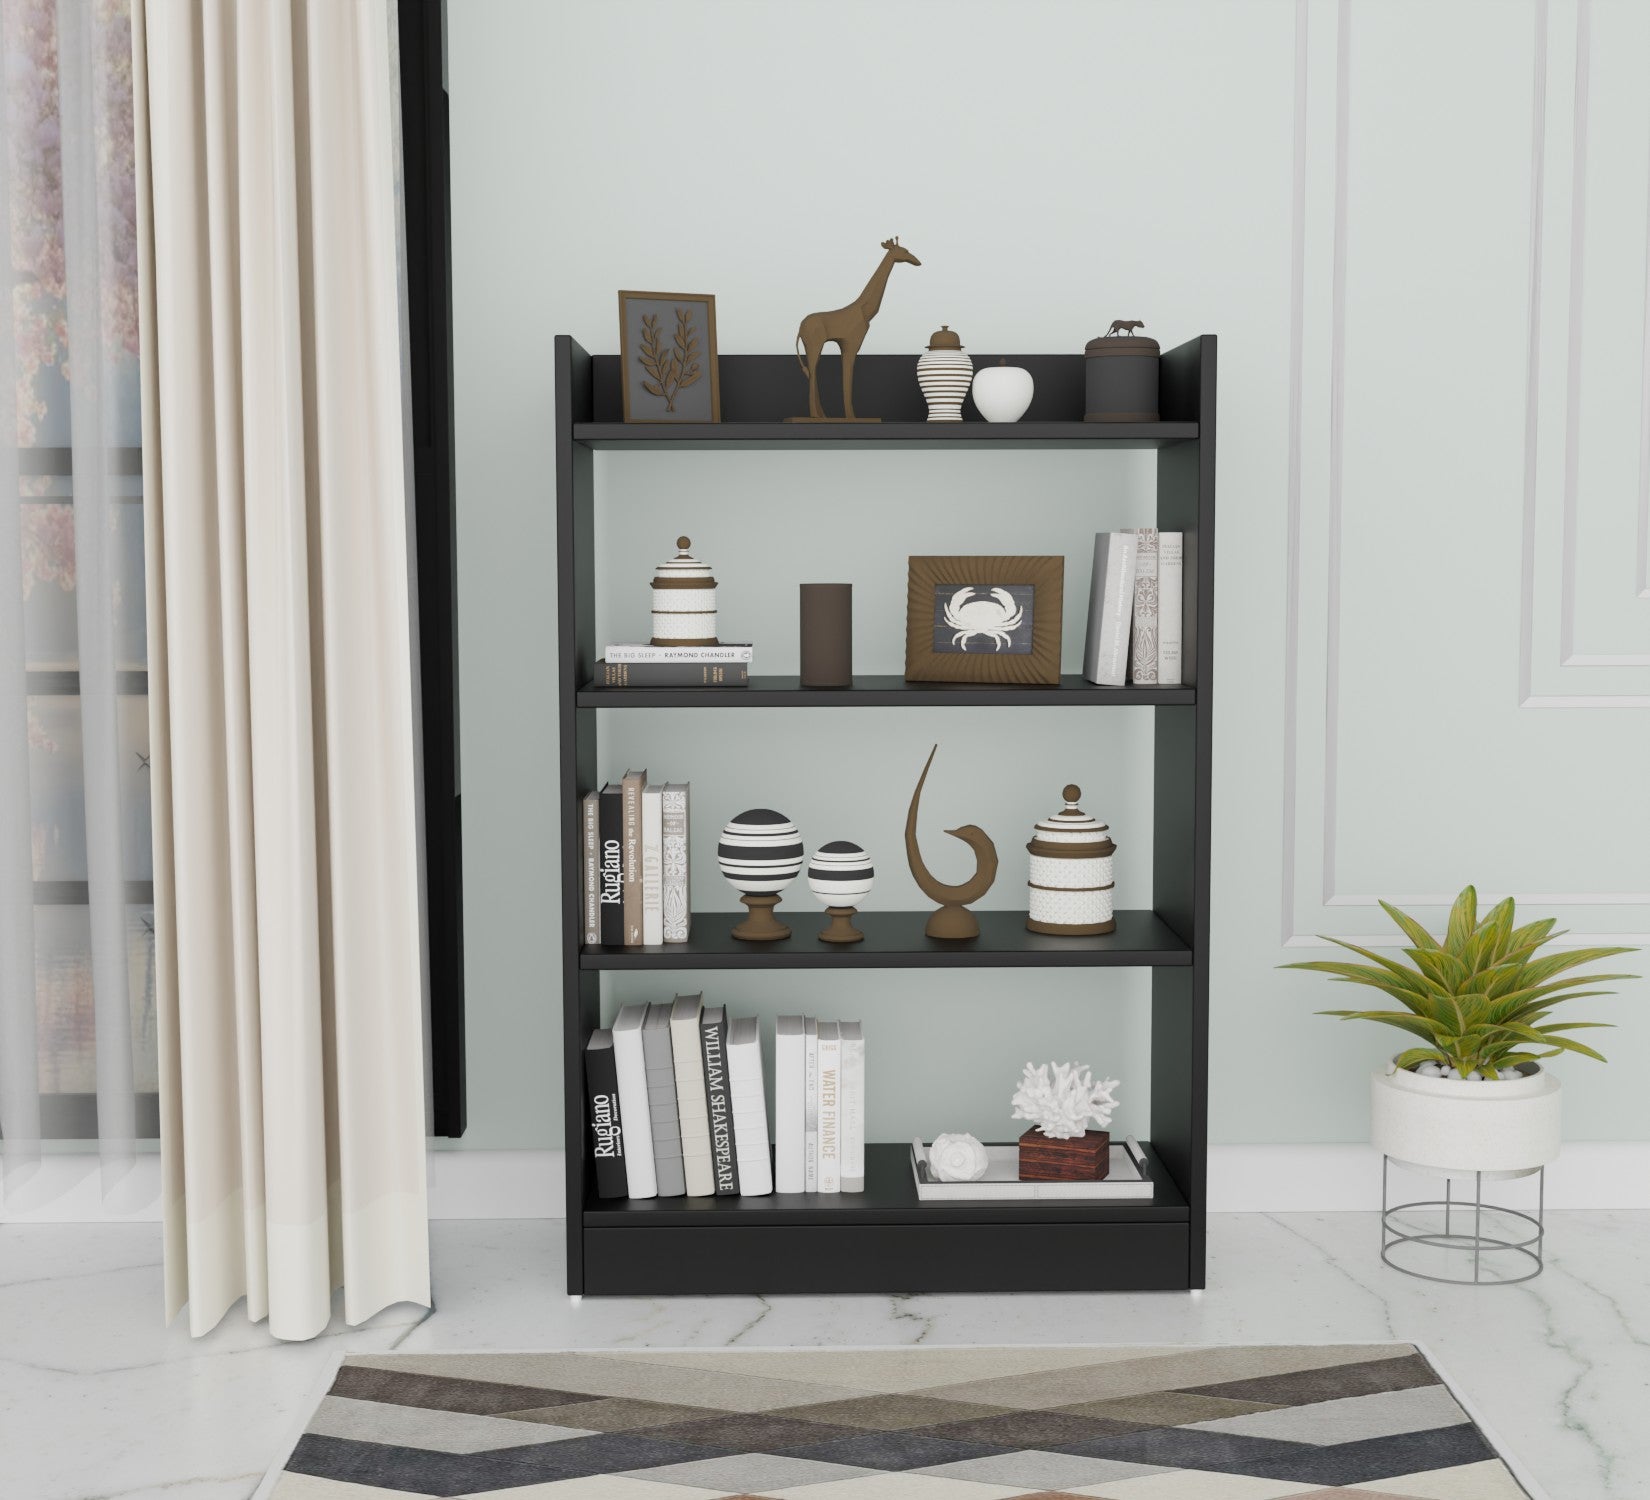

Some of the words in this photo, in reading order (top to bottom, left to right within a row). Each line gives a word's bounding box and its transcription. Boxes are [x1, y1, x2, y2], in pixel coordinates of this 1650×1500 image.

[627, 787, 635, 826] REVEALING
[600, 839, 624, 904] Rugiano
[628, 838, 637, 882] Revolution
[588, 893, 596, 928] CHANDLER
[704, 1025, 721, 1092] WILLIAM
[822, 1069, 836, 1109] WATER
[591, 1094, 621, 1159] Rugiano
[710, 1094, 734, 1192] SHAKESPEARE
[822, 1111, 836, 1160] FINANCE
